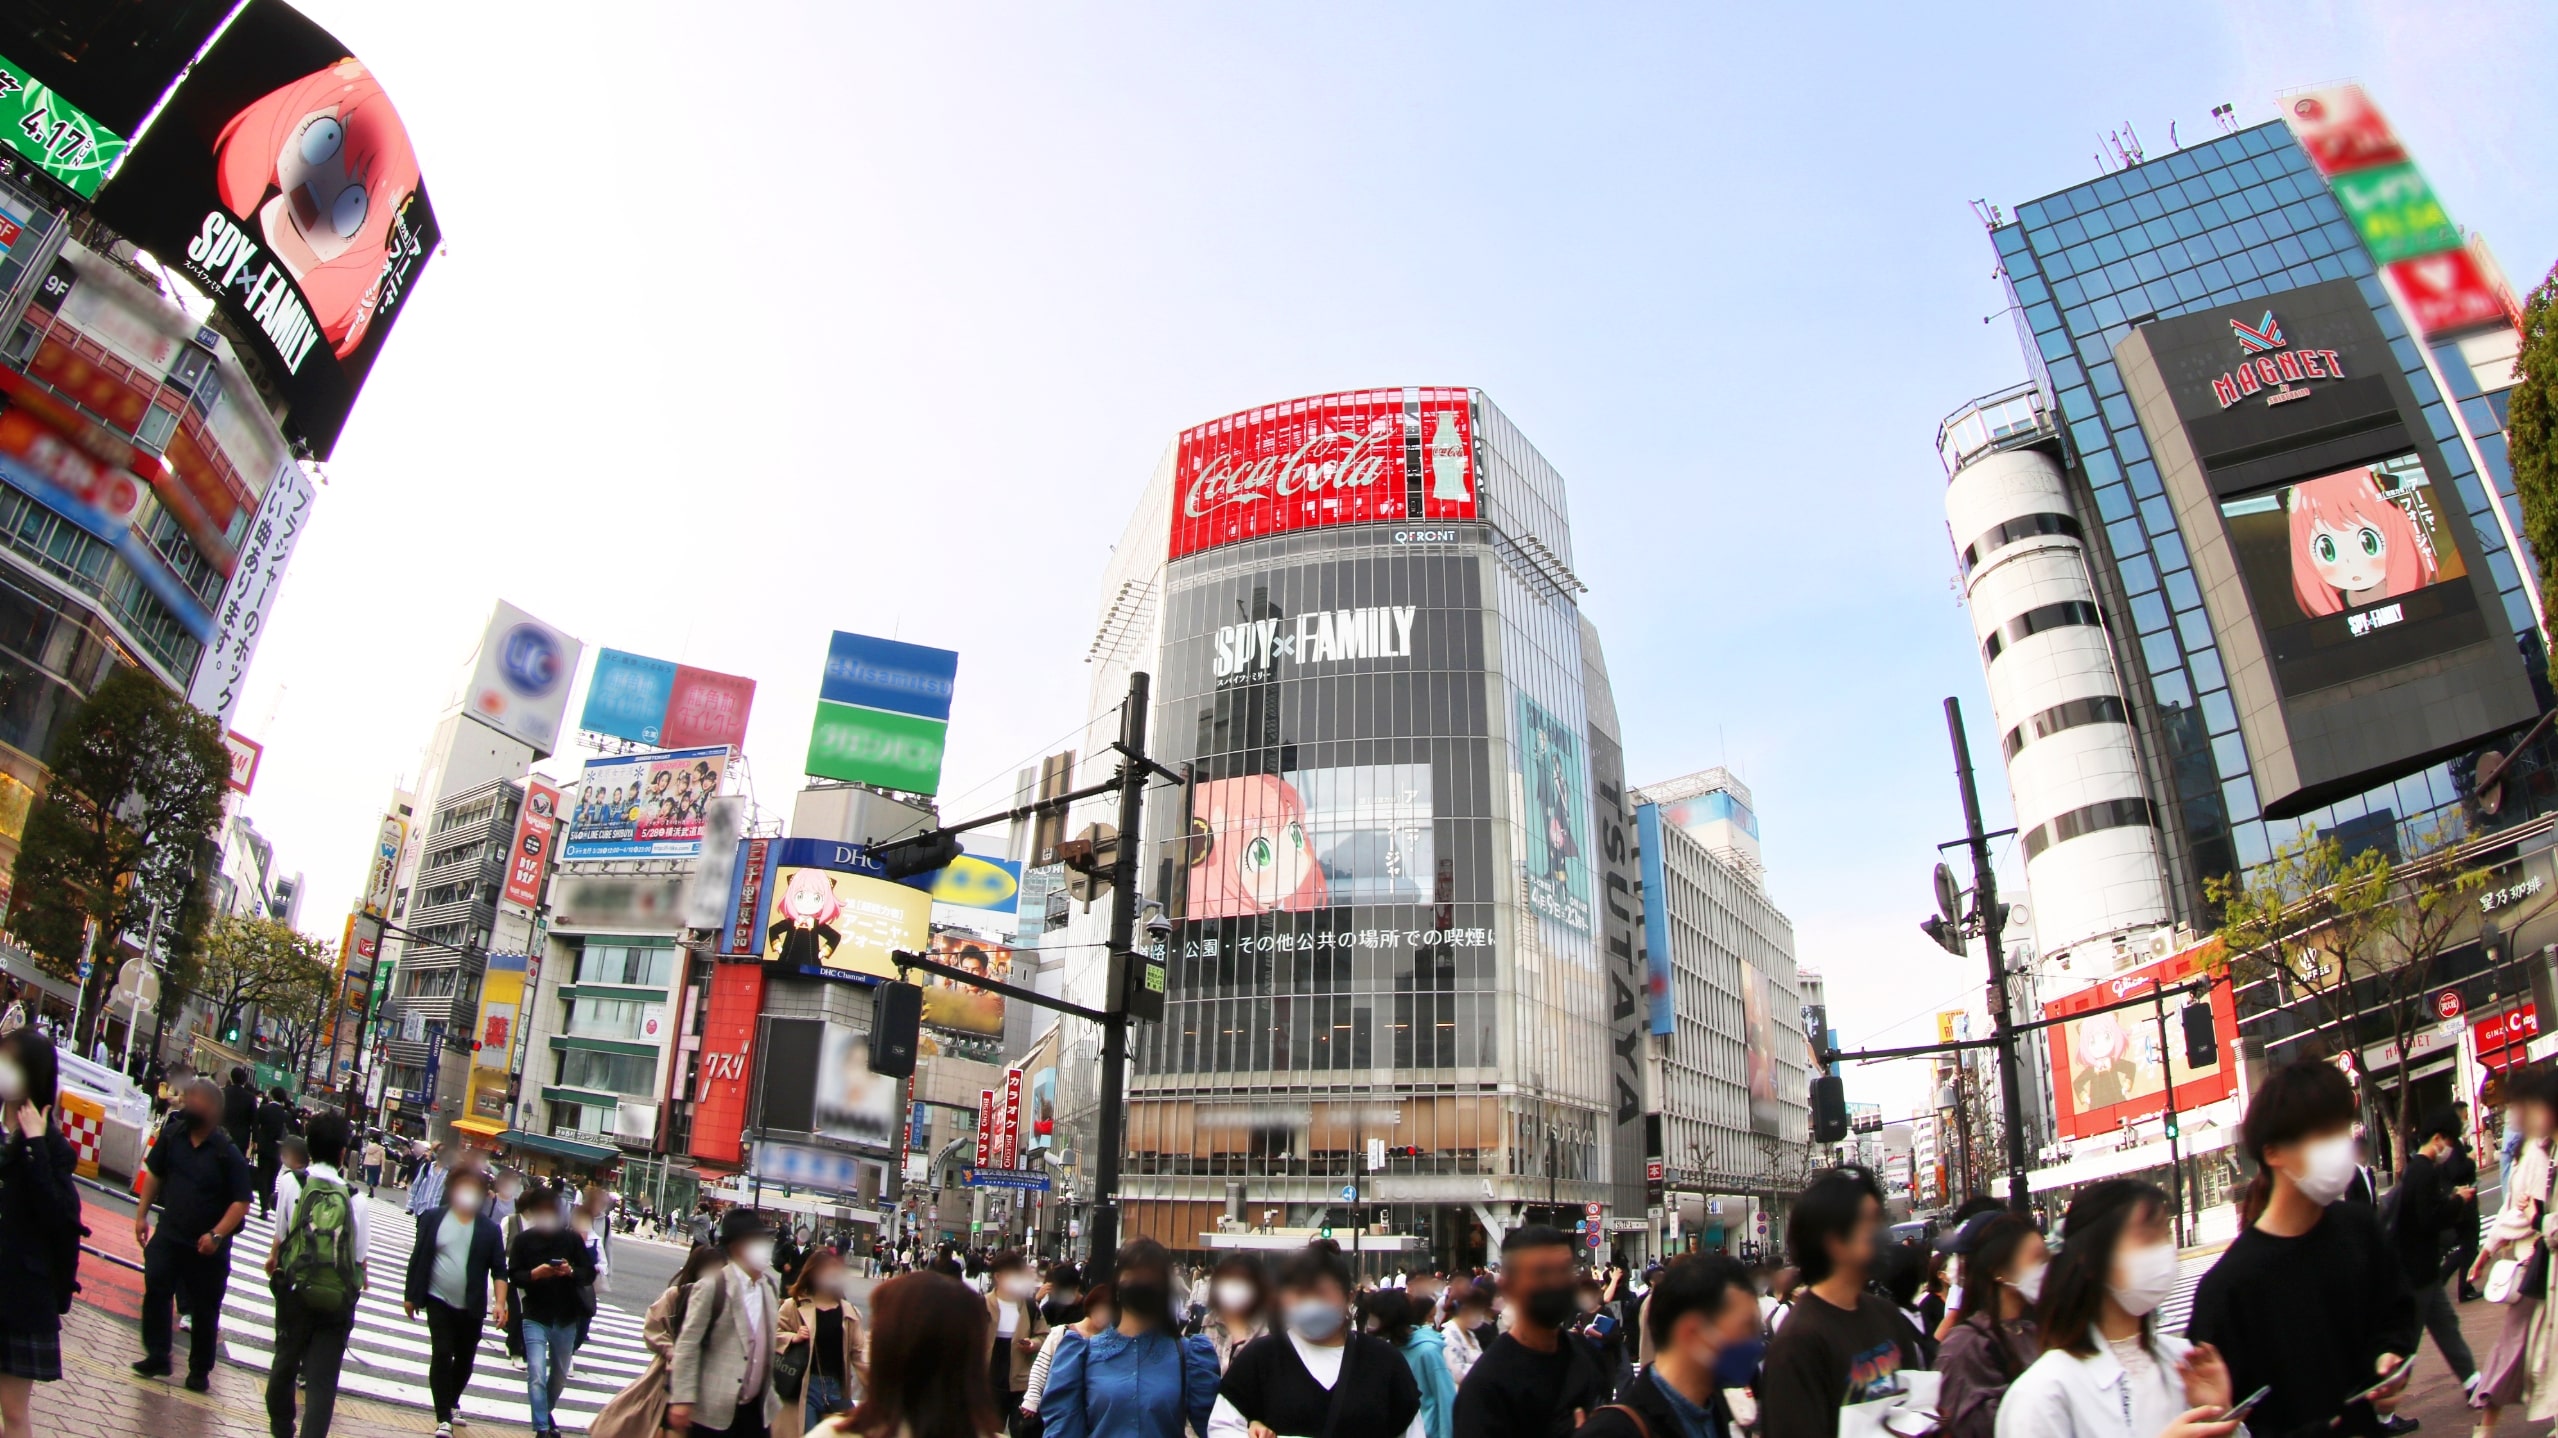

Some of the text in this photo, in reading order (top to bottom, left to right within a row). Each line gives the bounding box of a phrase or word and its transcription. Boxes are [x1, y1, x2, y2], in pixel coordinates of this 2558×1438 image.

[19, 107, 88, 159] 4.17
[45, 275, 69, 296] 9F
[183, 259, 226, 297] スパイファミリー
[2211, 349, 2346, 410] MAGNET
[1395, 531, 1455, 544] QFRONT
[213, 487, 311, 722] ブラジャーのホック
[1599, 780, 1640, 1126] TSUTAYA
[820, 967, 866, 982] DHC Channel
[485, 1015, 509, 1048] 薬
[1005, 1077, 1020, 1129] カラオケ
[1544, 1122, 1596, 1147] TSUTAYA
[1649, 1164, 1661, 1177] 本
